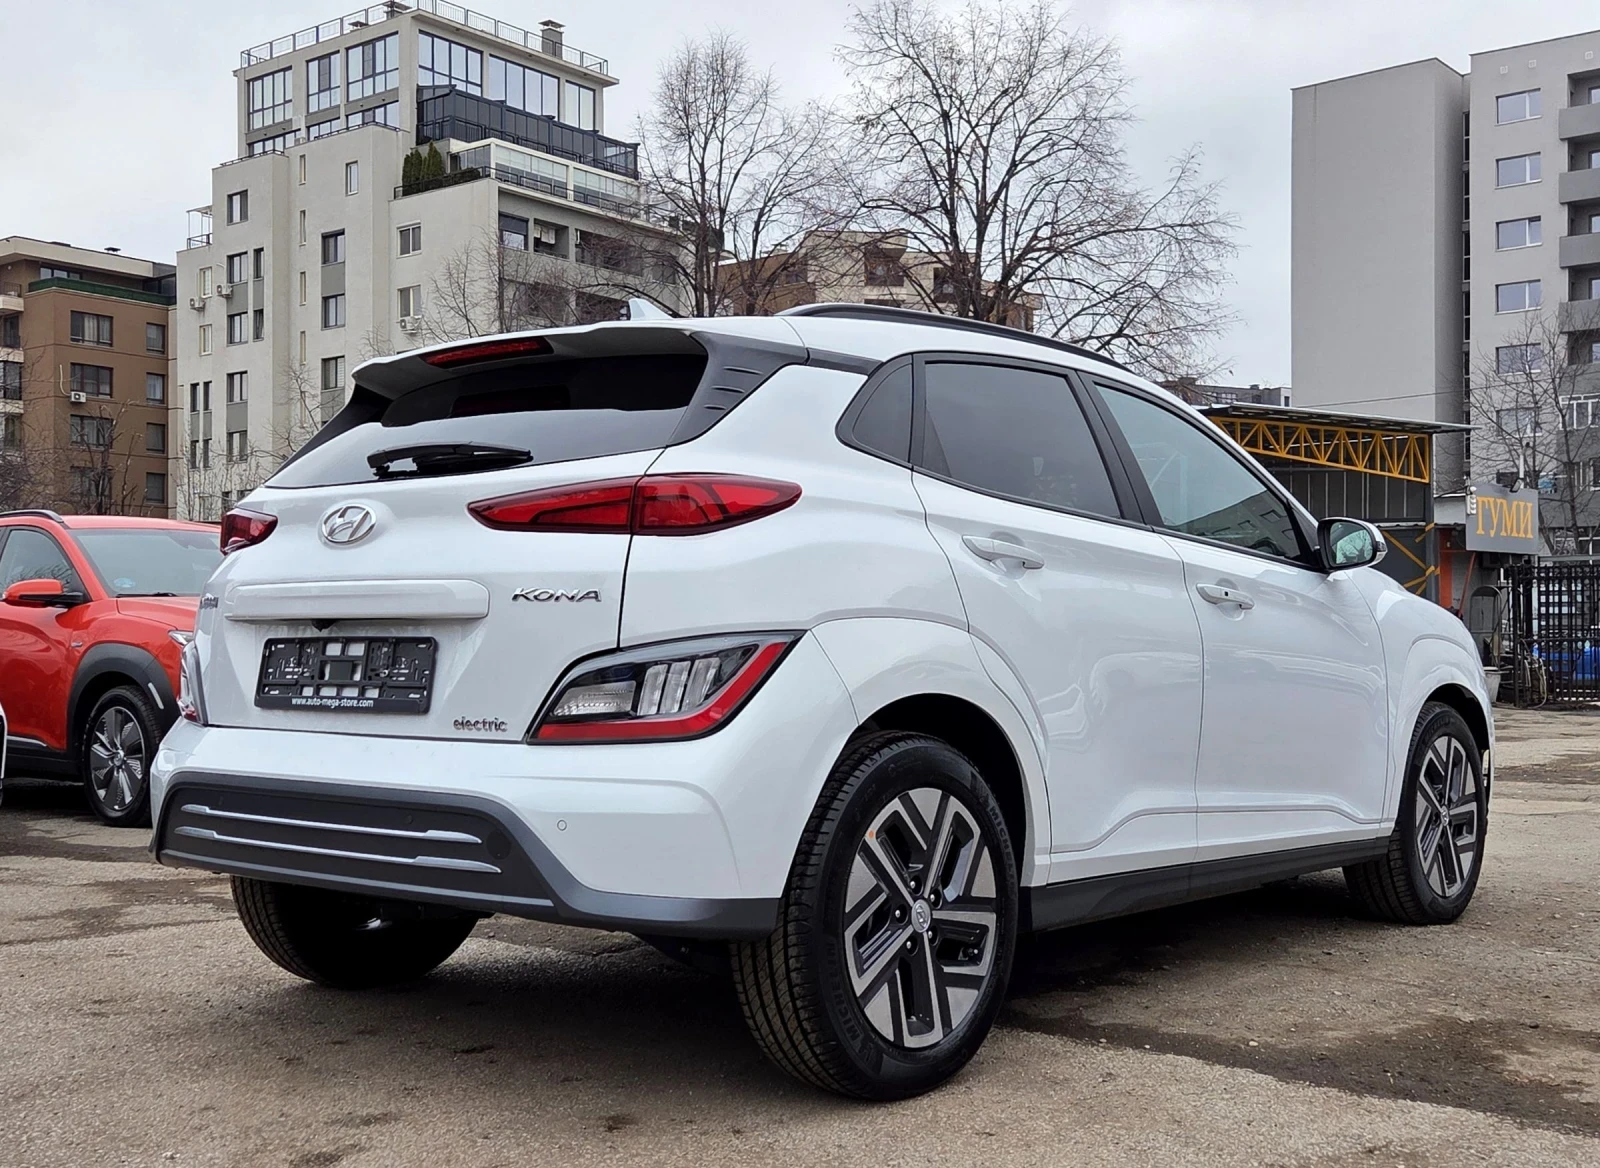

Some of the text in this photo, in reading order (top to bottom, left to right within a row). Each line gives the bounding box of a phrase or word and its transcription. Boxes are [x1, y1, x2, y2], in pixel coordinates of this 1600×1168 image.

[1476, 496, 1534, 538] ГУМИ
[511, 587, 602, 602] KONA
[291, 697, 374, 709] www.auto-mega-store.com
[453, 716, 508, 732] electric
